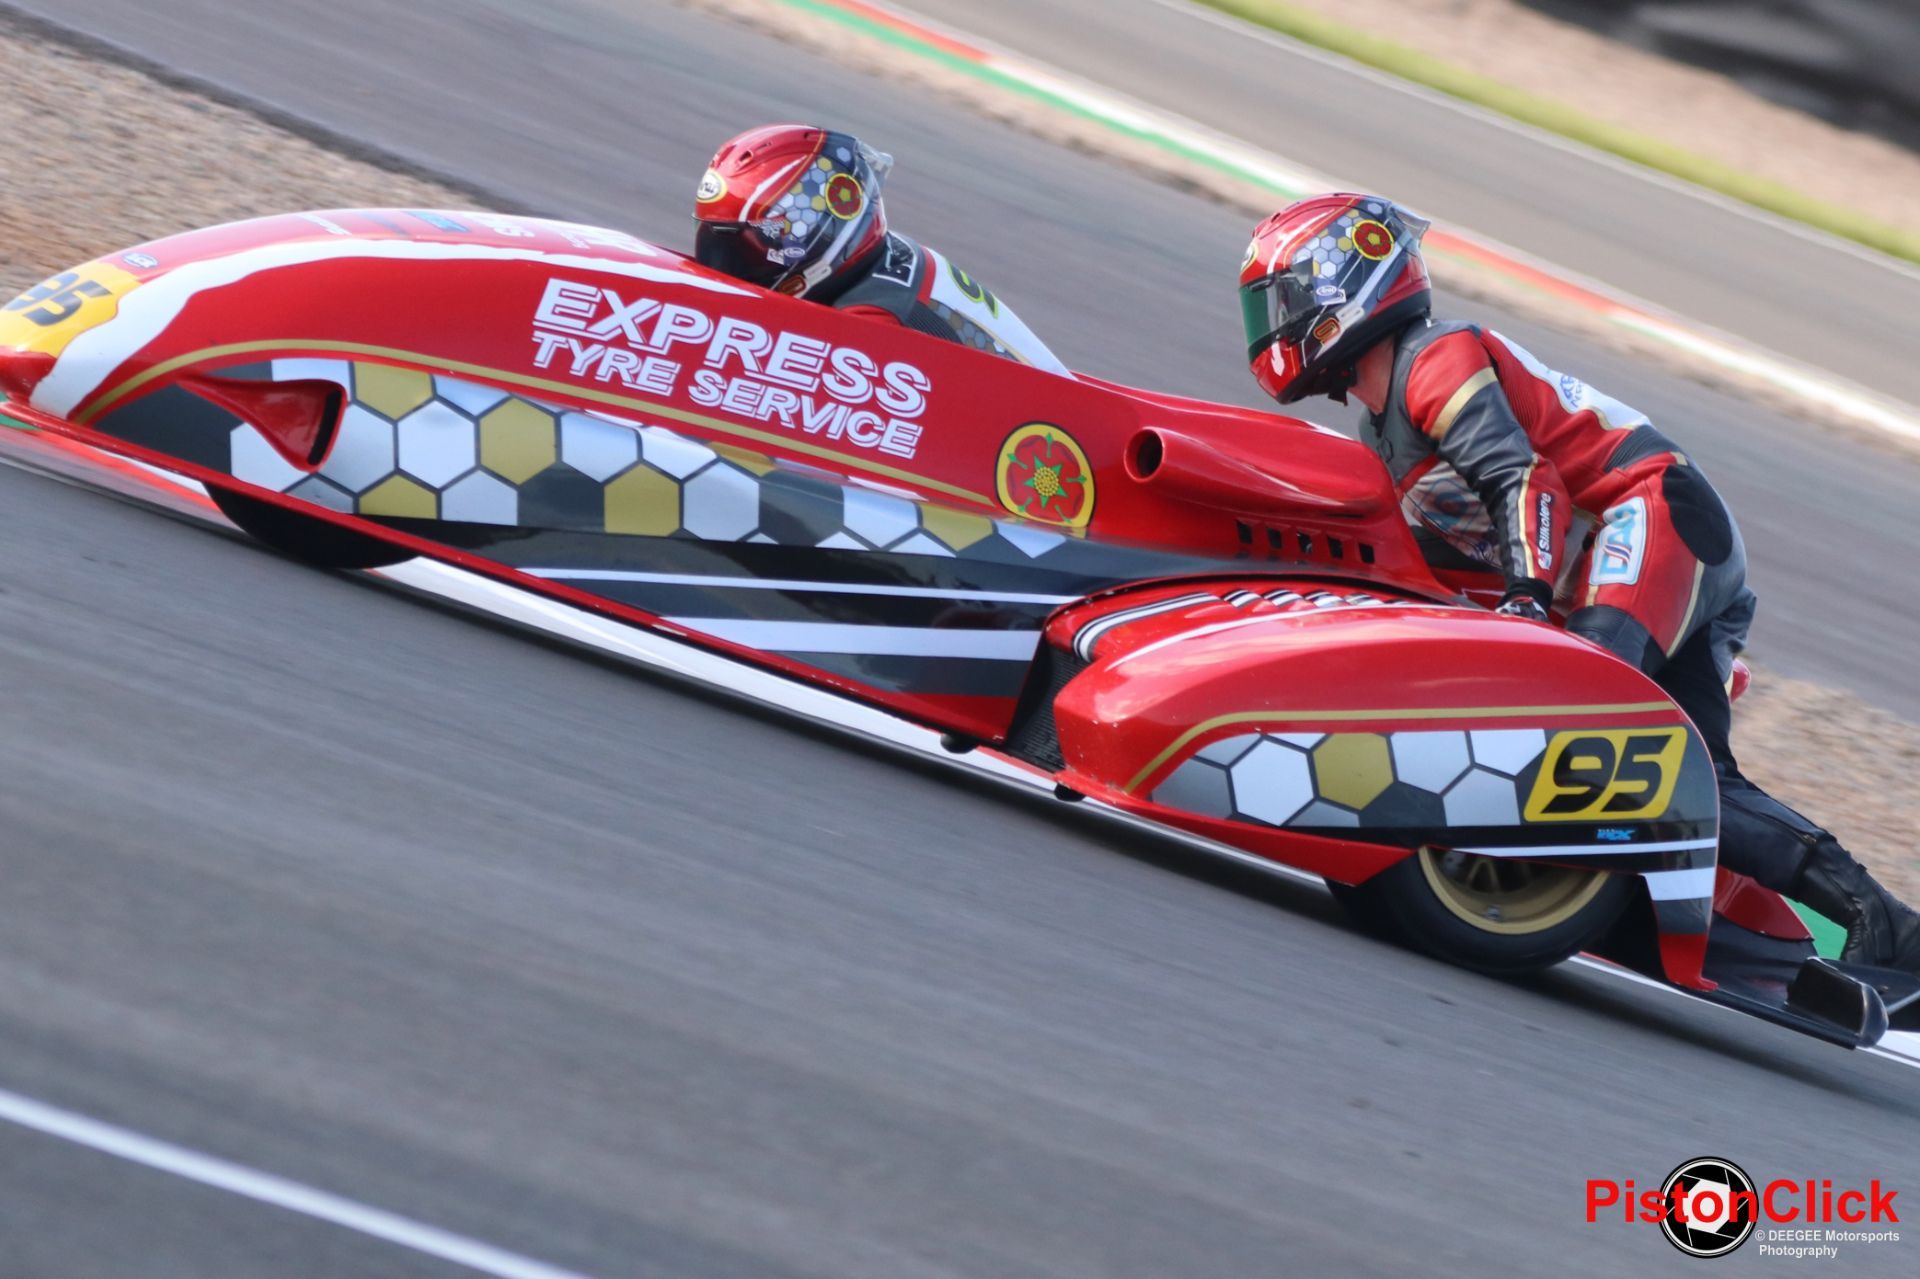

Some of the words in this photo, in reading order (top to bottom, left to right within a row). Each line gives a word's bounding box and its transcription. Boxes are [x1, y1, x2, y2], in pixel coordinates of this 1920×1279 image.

[5, 272, 112, 326] 95
[532, 278, 932, 419] EXPRESS
[532, 330, 681, 396] TYRE
[688, 369, 923, 459] SERVICE
[1539, 493, 1552, 551] Silkolene
[1540, 734, 1674, 813] 95
